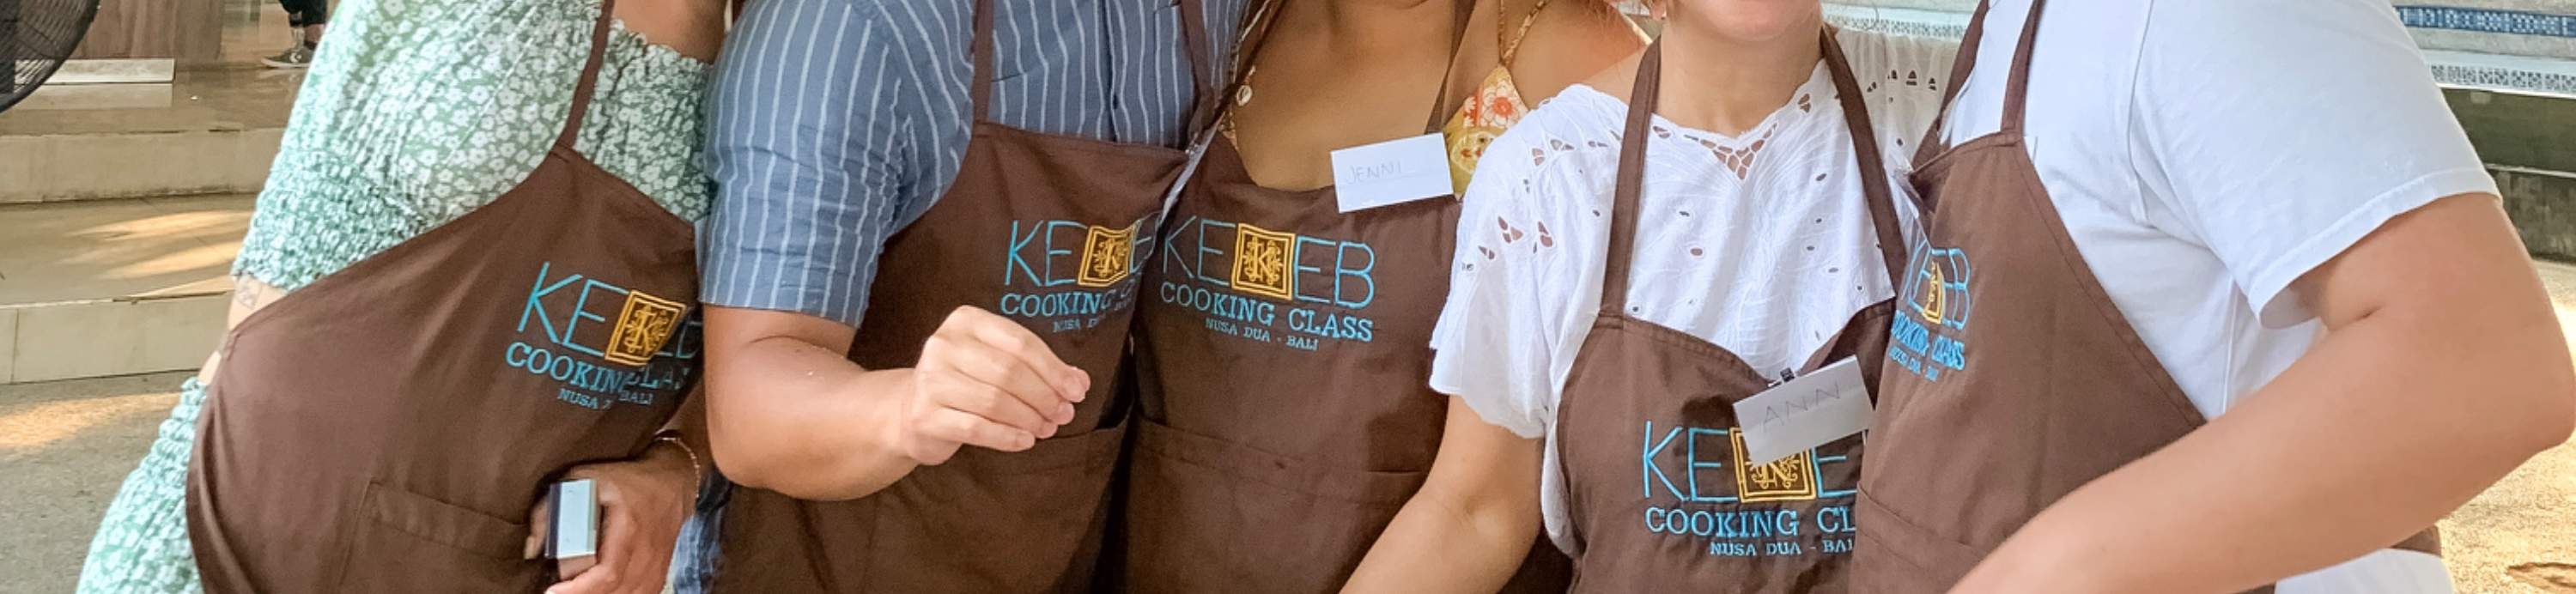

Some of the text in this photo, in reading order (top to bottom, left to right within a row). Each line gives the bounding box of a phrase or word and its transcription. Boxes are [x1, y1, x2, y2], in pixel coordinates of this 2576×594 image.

[1160, 282, 1275, 326] COOKING
[1288, 307, 1373, 342] CLASS
[1205, 318, 1237, 336] NUSA
[1245, 326, 1271, 342] DUA
[1286, 335, 1319, 351] BALI
[505, 342, 626, 393] COOKIN
[1763, 380, 1840, 429] ANN
[1644, 506, 1800, 538] COOKING
[1710, 542, 1758, 556] NUSA
[1765, 541, 1802, 555] DUA
